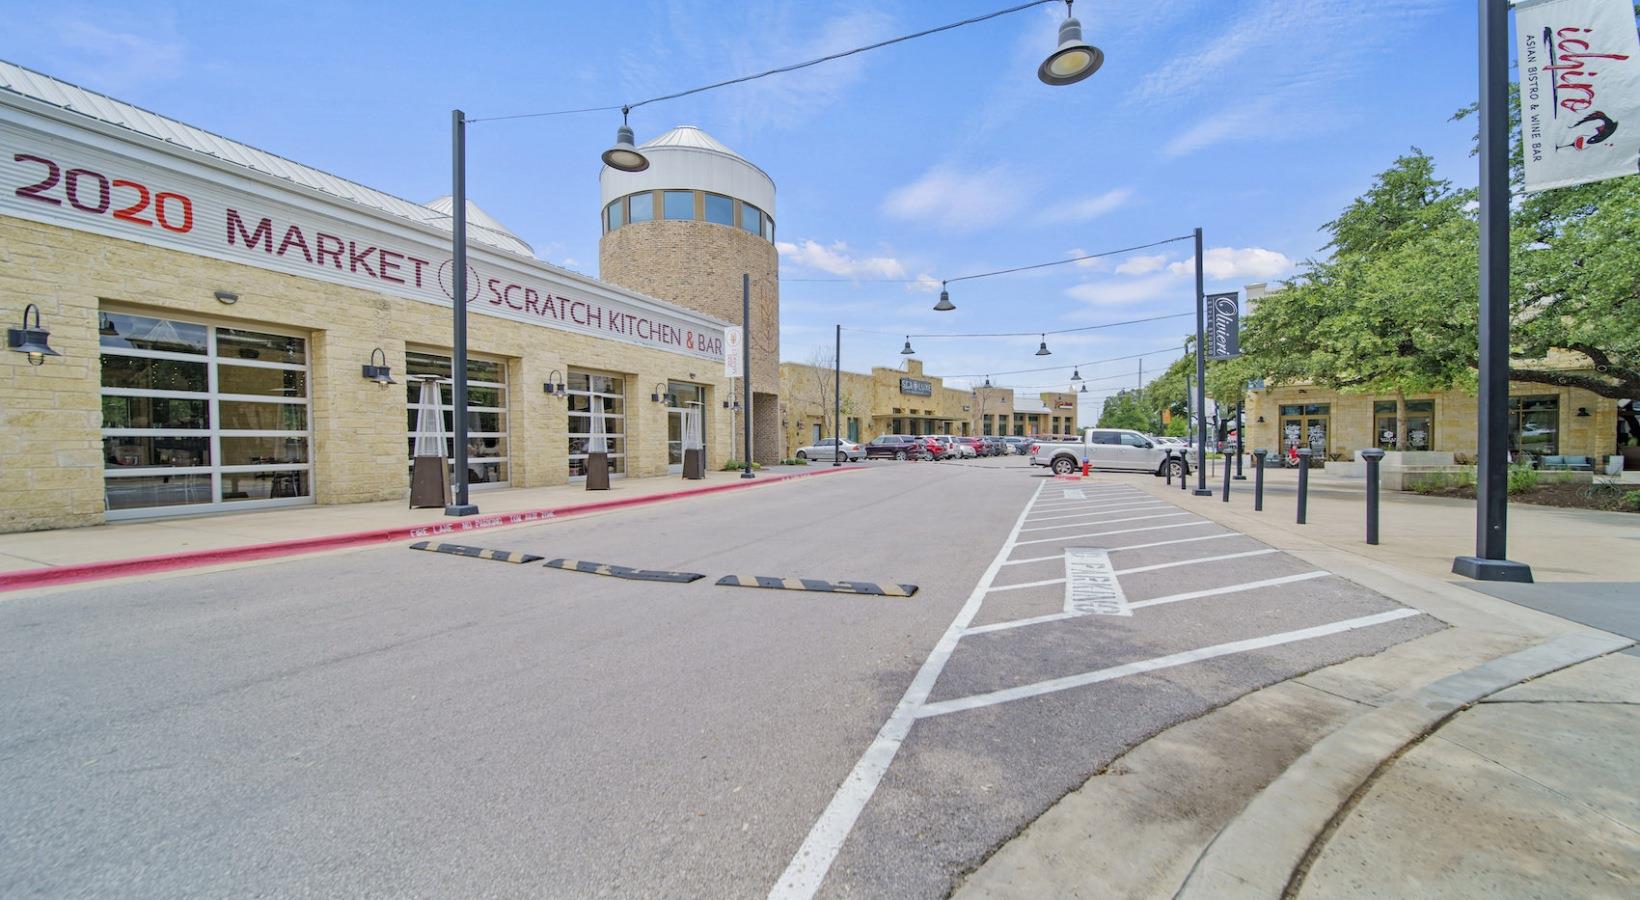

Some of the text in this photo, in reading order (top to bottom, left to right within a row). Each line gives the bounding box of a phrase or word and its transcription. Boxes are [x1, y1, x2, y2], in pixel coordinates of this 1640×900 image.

[1526, 35, 1542, 163] ASIAN BISTRO & WINE BAR
[1542, 27, 1630, 113] ichiro
[13, 153, 430, 289] 2020 MARKET
[488, 278, 723, 356] SCRATCH KITCHEN & BAR
[1215, 297, 1237, 355] Olivieri
[432, 523, 454, 535] LANE
[1070, 562, 1121, 614] PARKING
